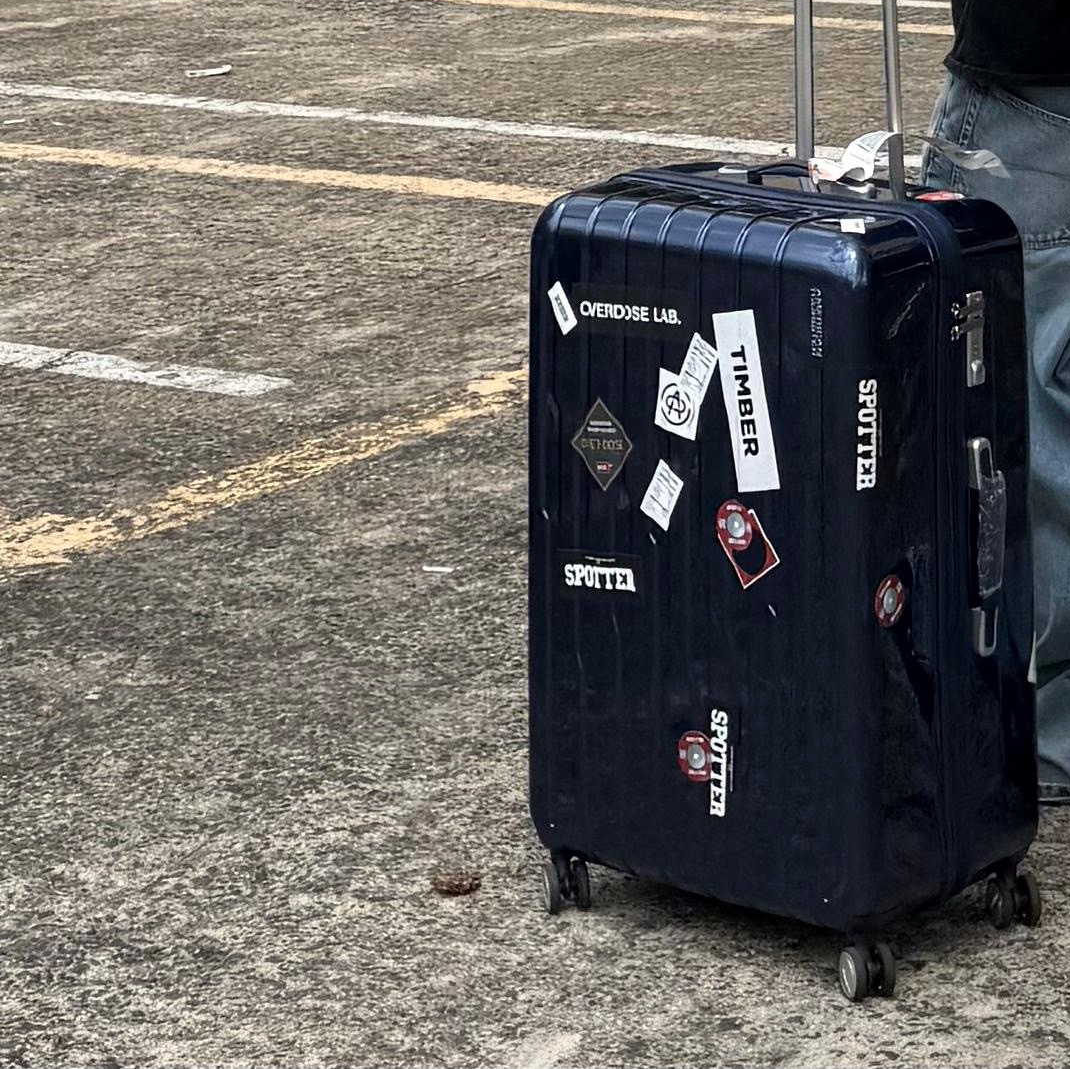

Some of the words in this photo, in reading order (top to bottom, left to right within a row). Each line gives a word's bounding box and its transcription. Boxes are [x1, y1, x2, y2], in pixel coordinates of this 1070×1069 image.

[580, 300, 650, 323] OVERDOSE
[653, 306, 682, 325] LAB.
[730, 344, 760, 458] TIMBER
[856, 379, 878, 491] SPOTTER
[564, 563, 636, 592] SPOTTER
[710, 709, 728, 817] SPOTTER
